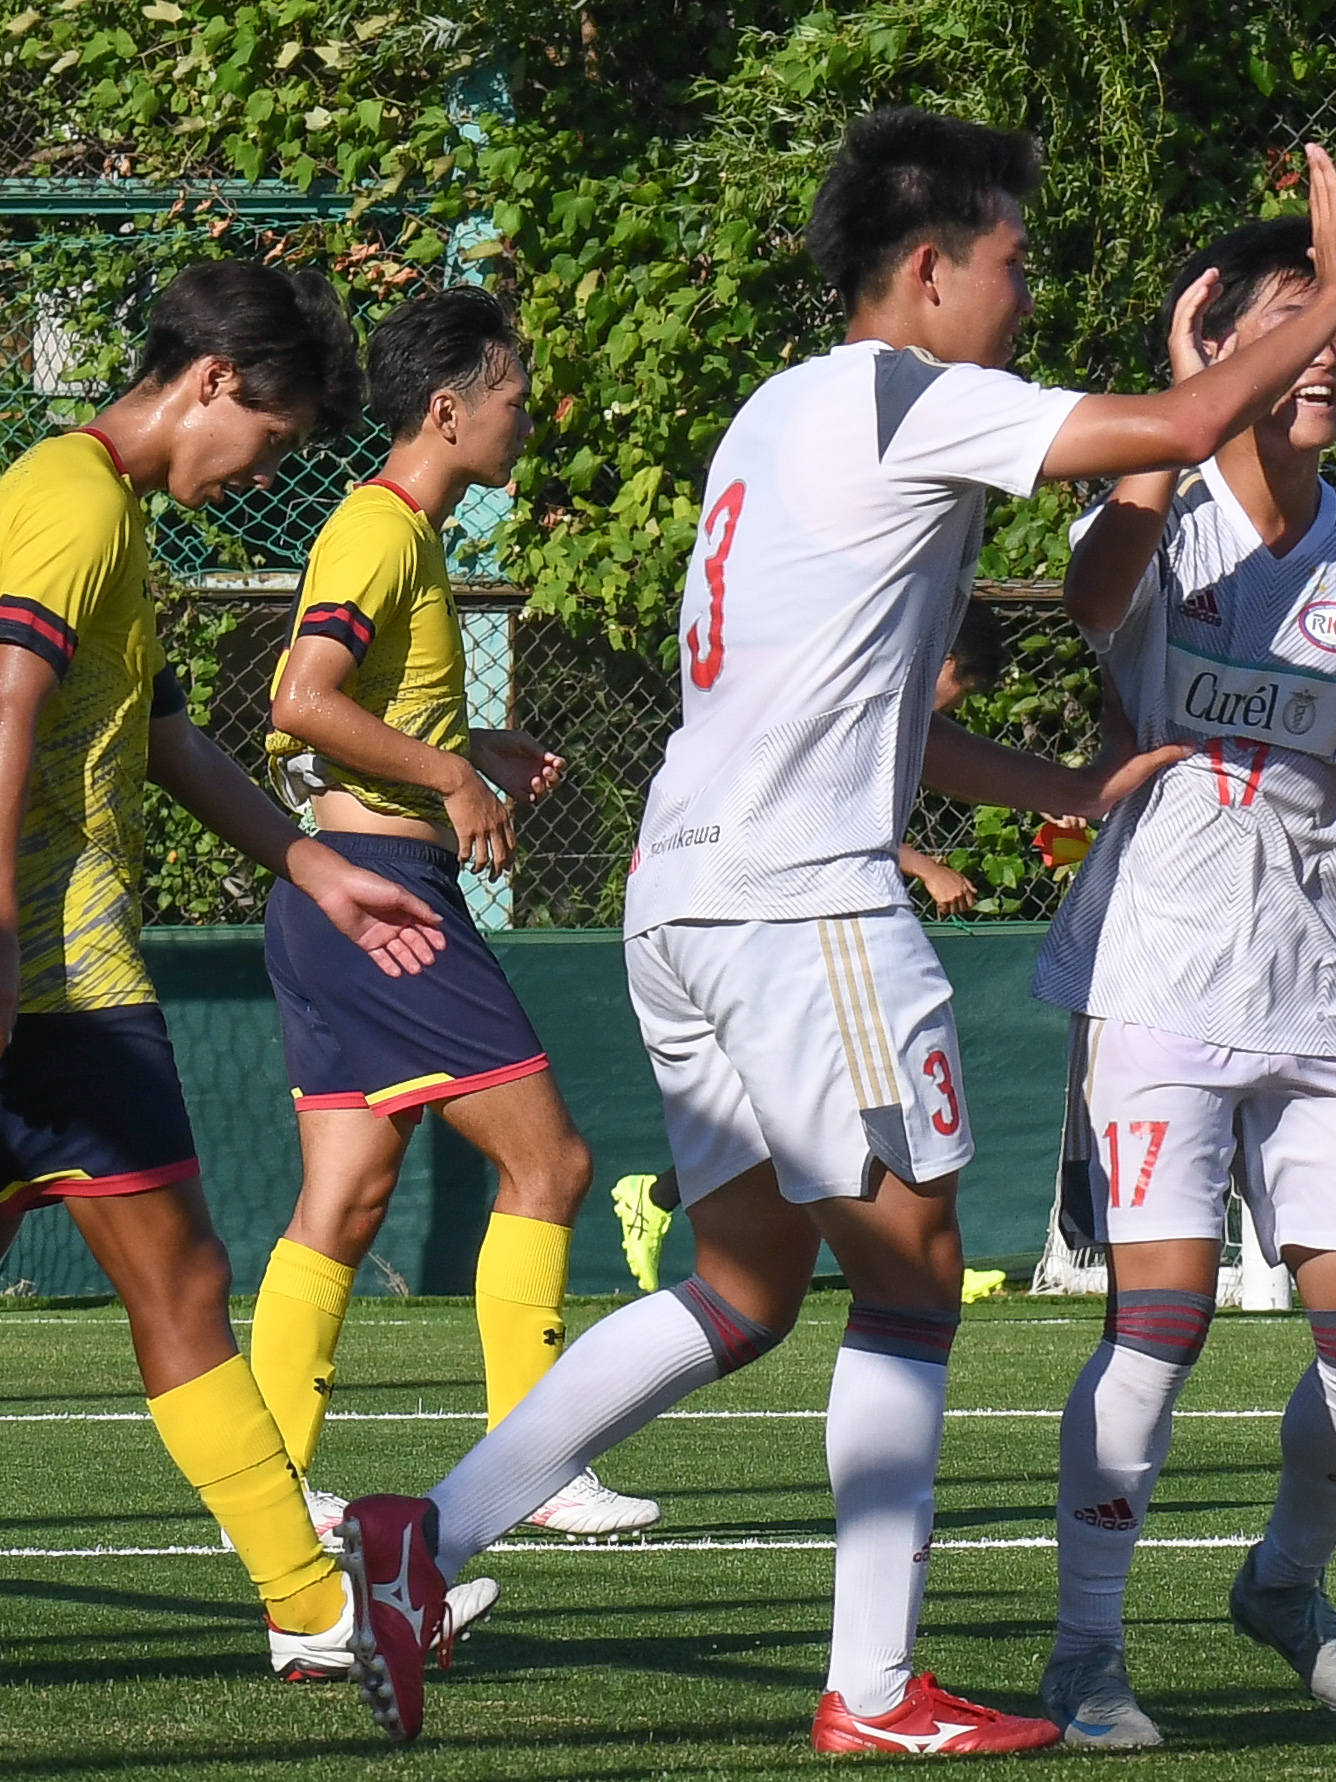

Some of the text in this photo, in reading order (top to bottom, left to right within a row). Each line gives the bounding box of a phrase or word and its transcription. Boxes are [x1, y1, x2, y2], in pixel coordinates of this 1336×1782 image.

[686, 478, 747, 692] 3
[1184, 671, 1279, 731] Curél
[1205, 738, 1270, 806] 17
[923, 1050, 960, 1137] 3
[1102, 1121, 1170, 1208] 17
[1074, 1507, 1139, 1531] adidas
